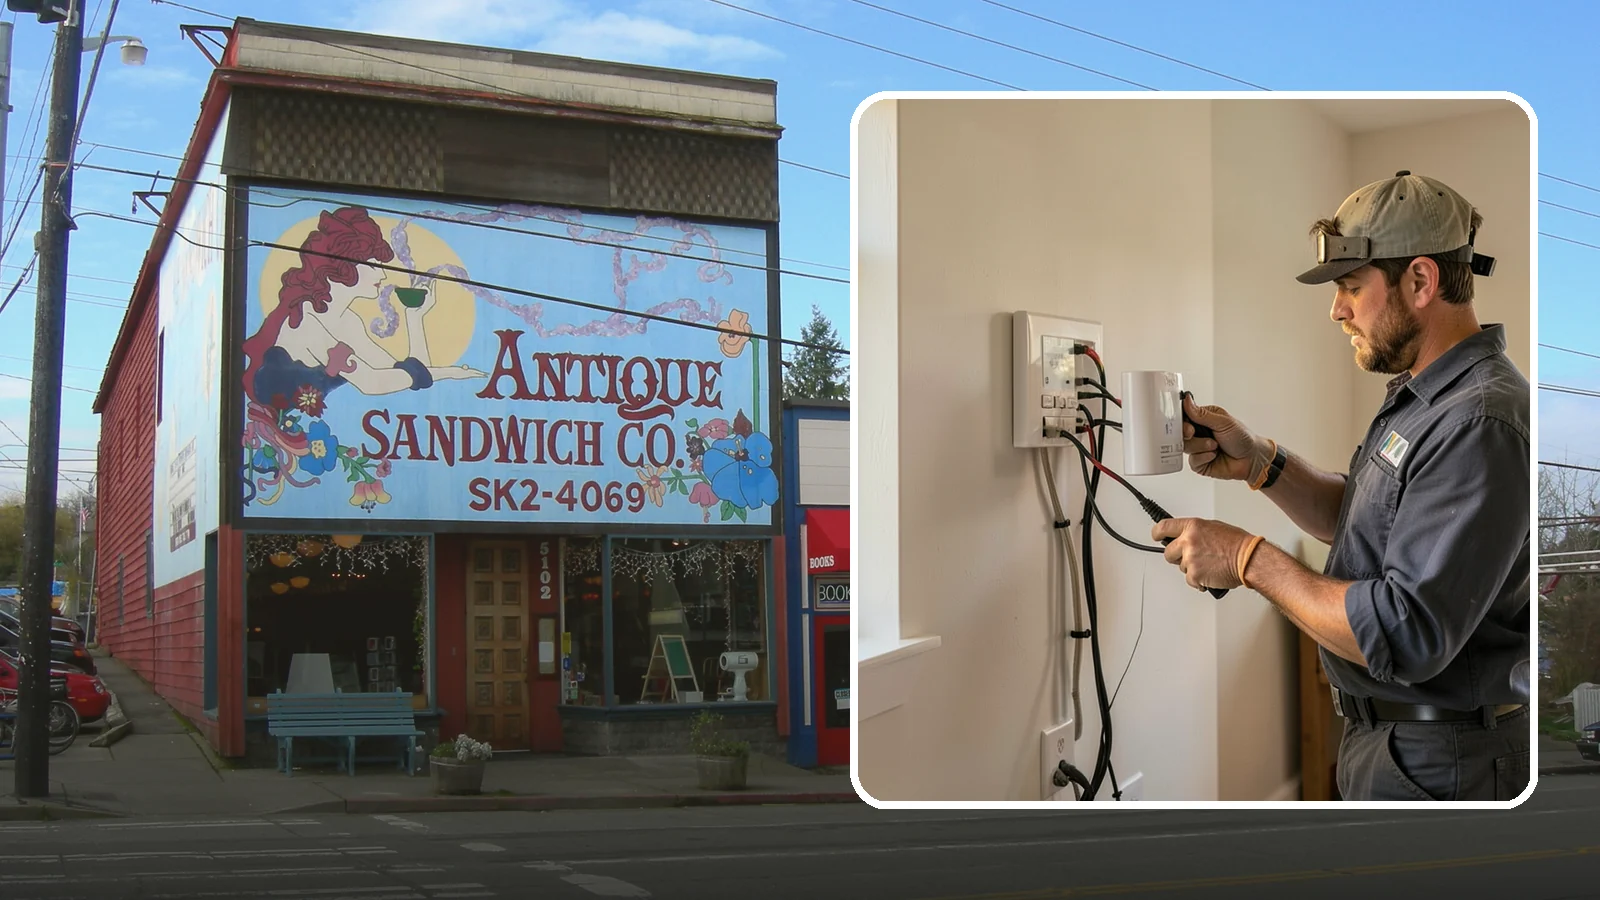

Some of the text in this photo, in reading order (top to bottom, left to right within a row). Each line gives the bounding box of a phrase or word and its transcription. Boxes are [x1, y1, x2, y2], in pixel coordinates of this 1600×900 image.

[475, 329, 723, 421] ANTIQUE
[361, 409, 685, 469] SANDWICH CO.
[468, 477, 645, 513] SK2-4069
[540, 542, 551, 600] 5102
[809, 555, 835, 569] BOOKS
